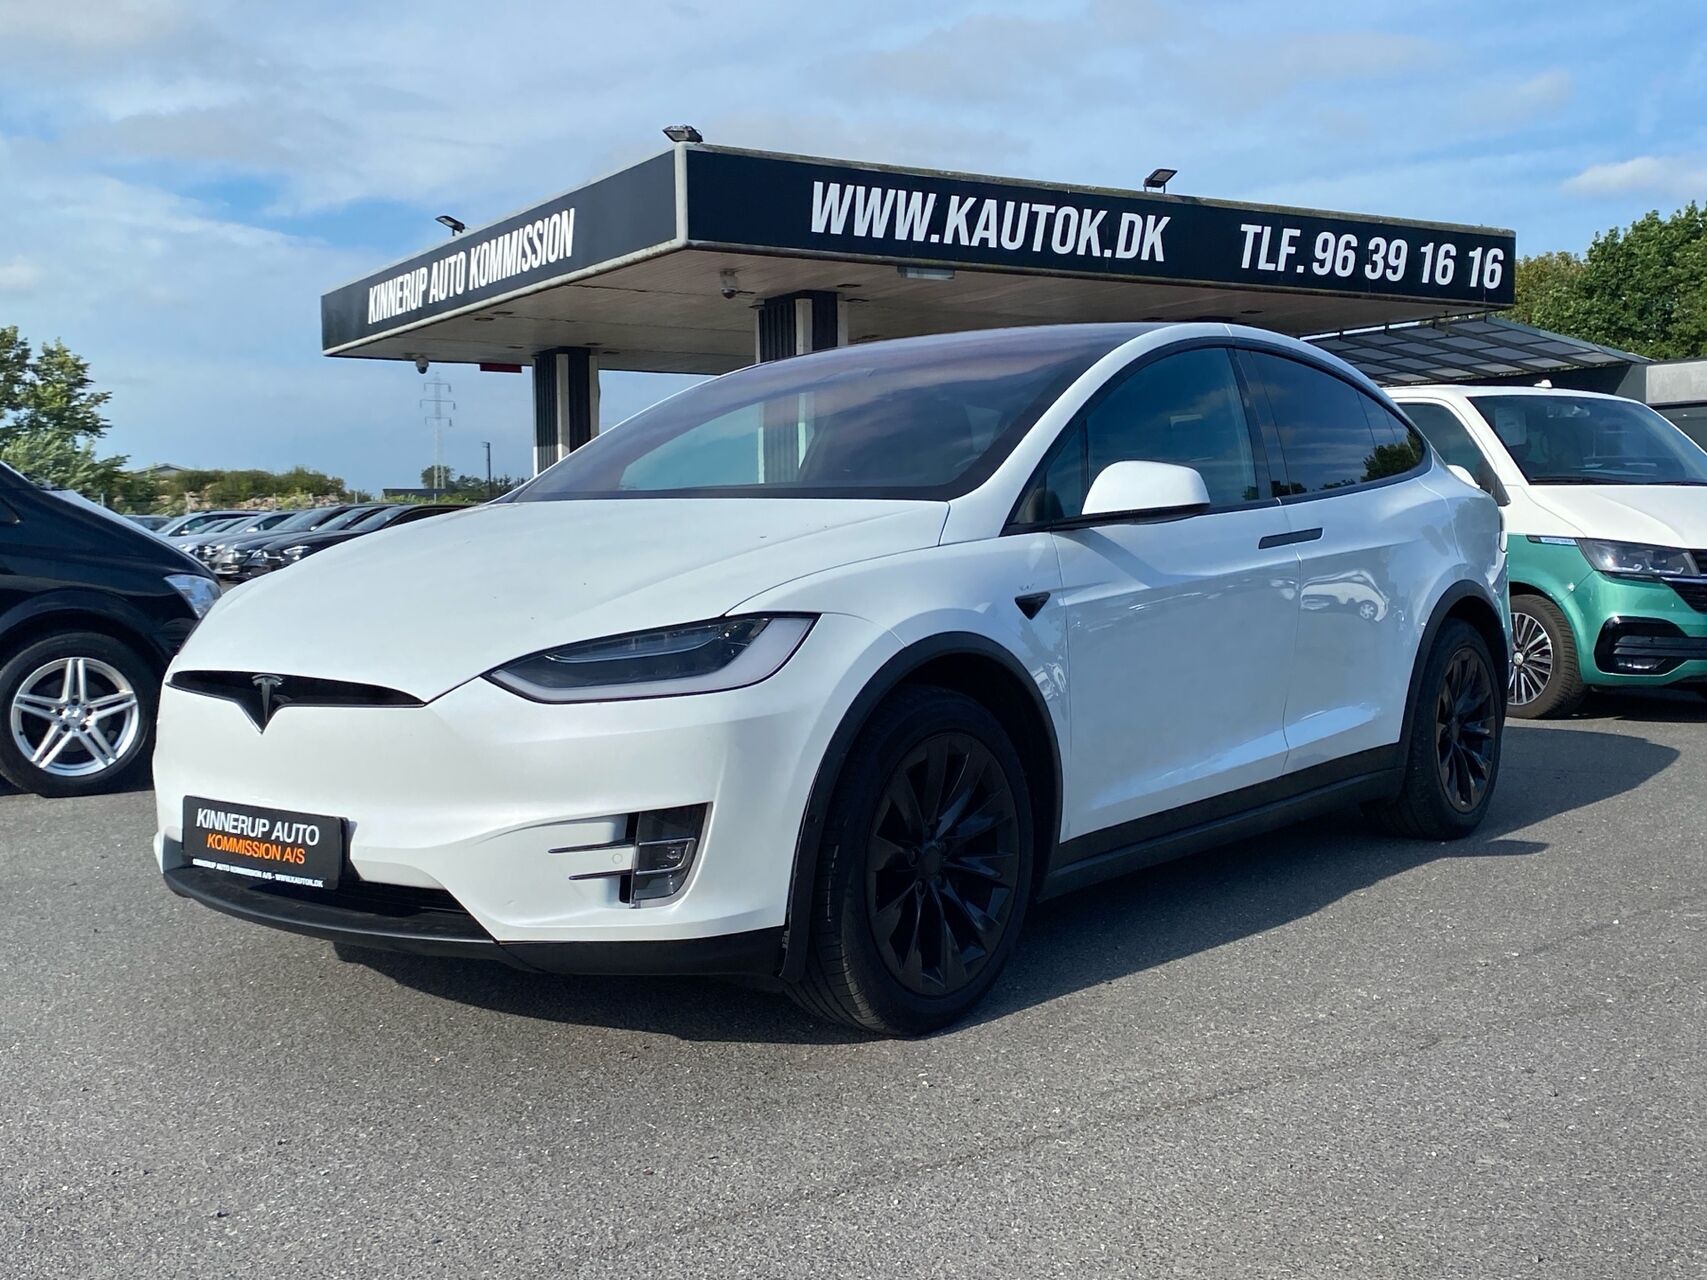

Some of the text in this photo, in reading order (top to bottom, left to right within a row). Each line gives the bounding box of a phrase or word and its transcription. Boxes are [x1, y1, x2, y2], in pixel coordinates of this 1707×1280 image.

[811, 181, 1171, 262] WWW.KAUTOK.DK
[368, 207, 575, 324] KINNERUP AUTO KOMMISSION
[1241, 223, 1504, 289] TLF. 96 39 16 16
[196, 808, 320, 846] KINNERUP AUTO
[206, 833, 306, 865] KOMMISSION A/S
